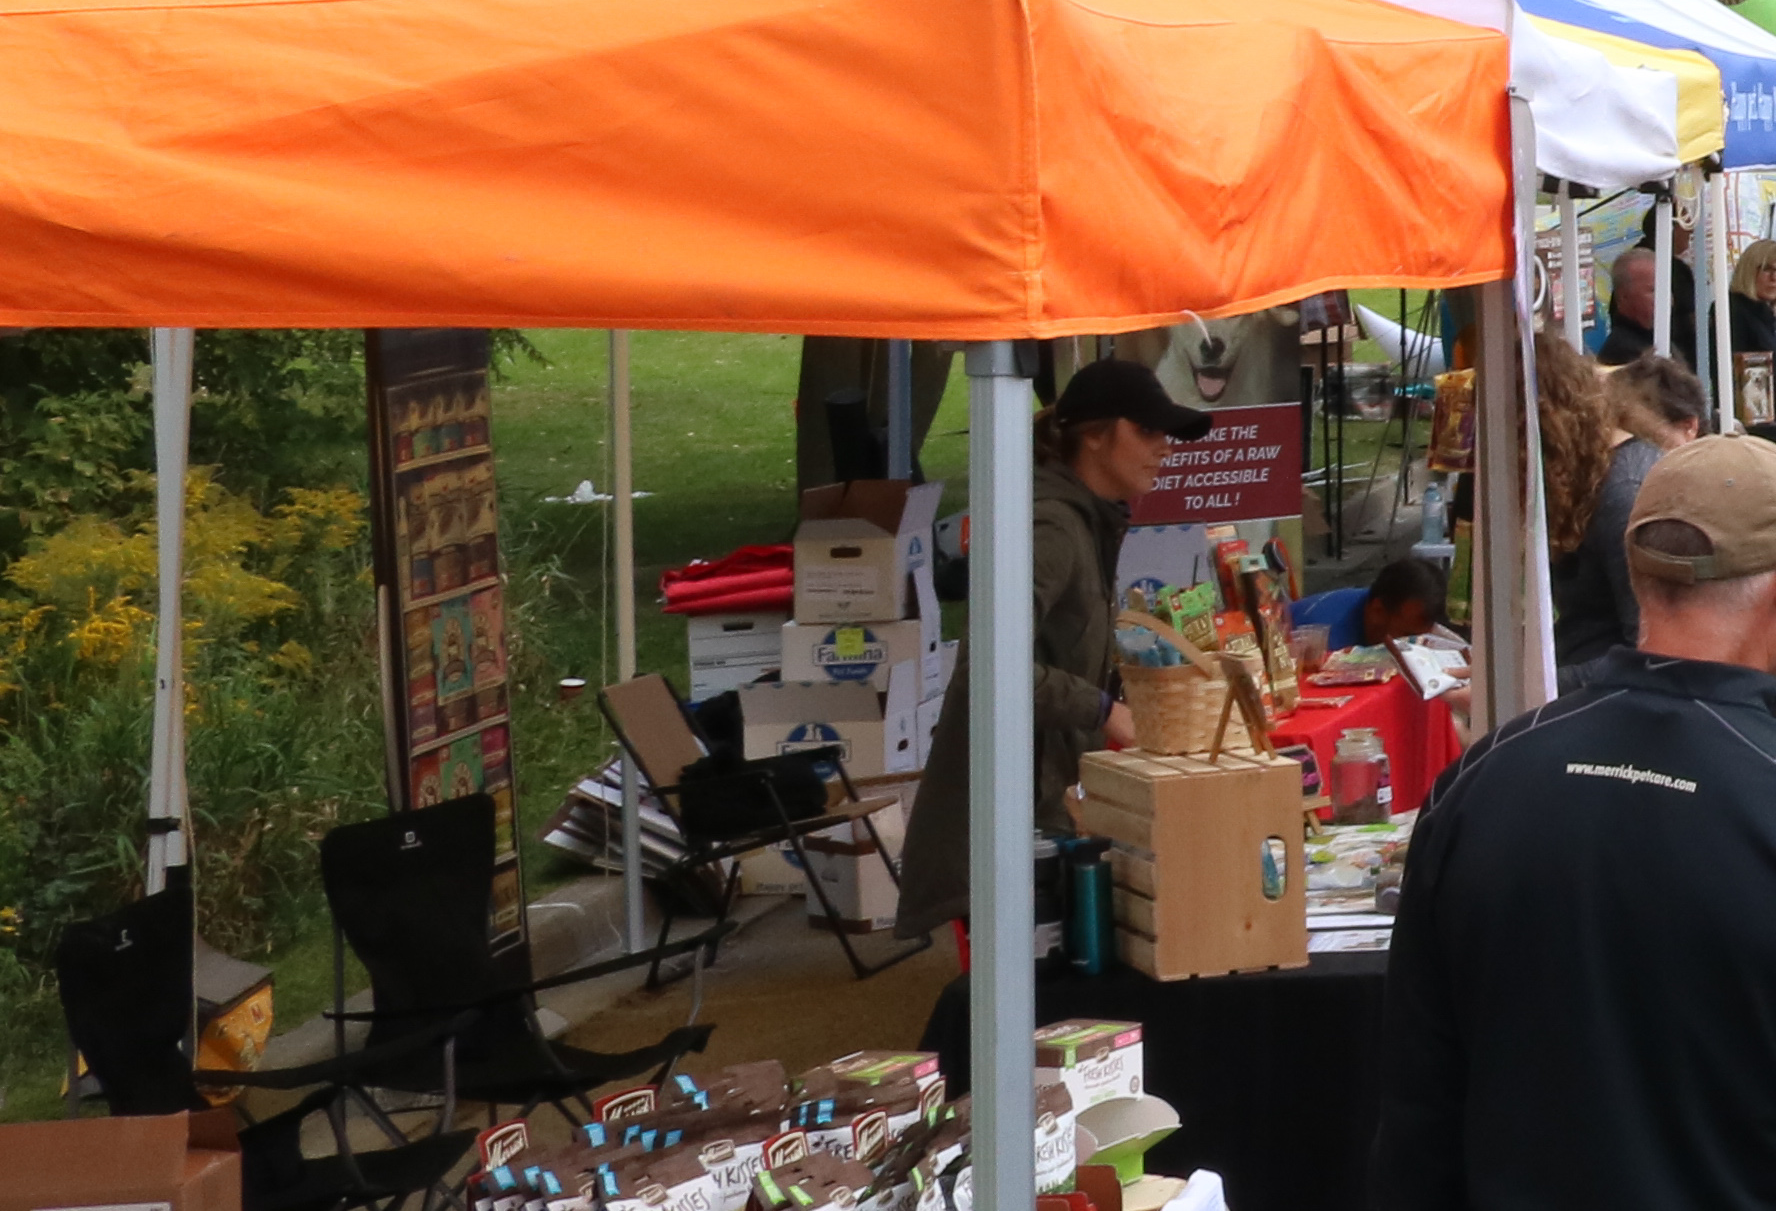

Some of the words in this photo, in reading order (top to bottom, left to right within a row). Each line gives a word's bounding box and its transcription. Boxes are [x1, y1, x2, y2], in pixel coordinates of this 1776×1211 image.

[1231, 425, 1258, 440] THE
[1160, 451, 1210, 467] NEFITS
[1213, 449, 1234, 463] OF
[1234, 449, 1244, 461] A
[1247, 445, 1281, 460] RAW
[1151, 475, 1182, 491] DIET
[1184, 468, 1270, 488] ACCESSIBLE
[1184, 495, 1201, 510] TO
[1205, 494, 1231, 509] ALL
[1566, 763, 1697, 793] www.merrickpetcare.com
